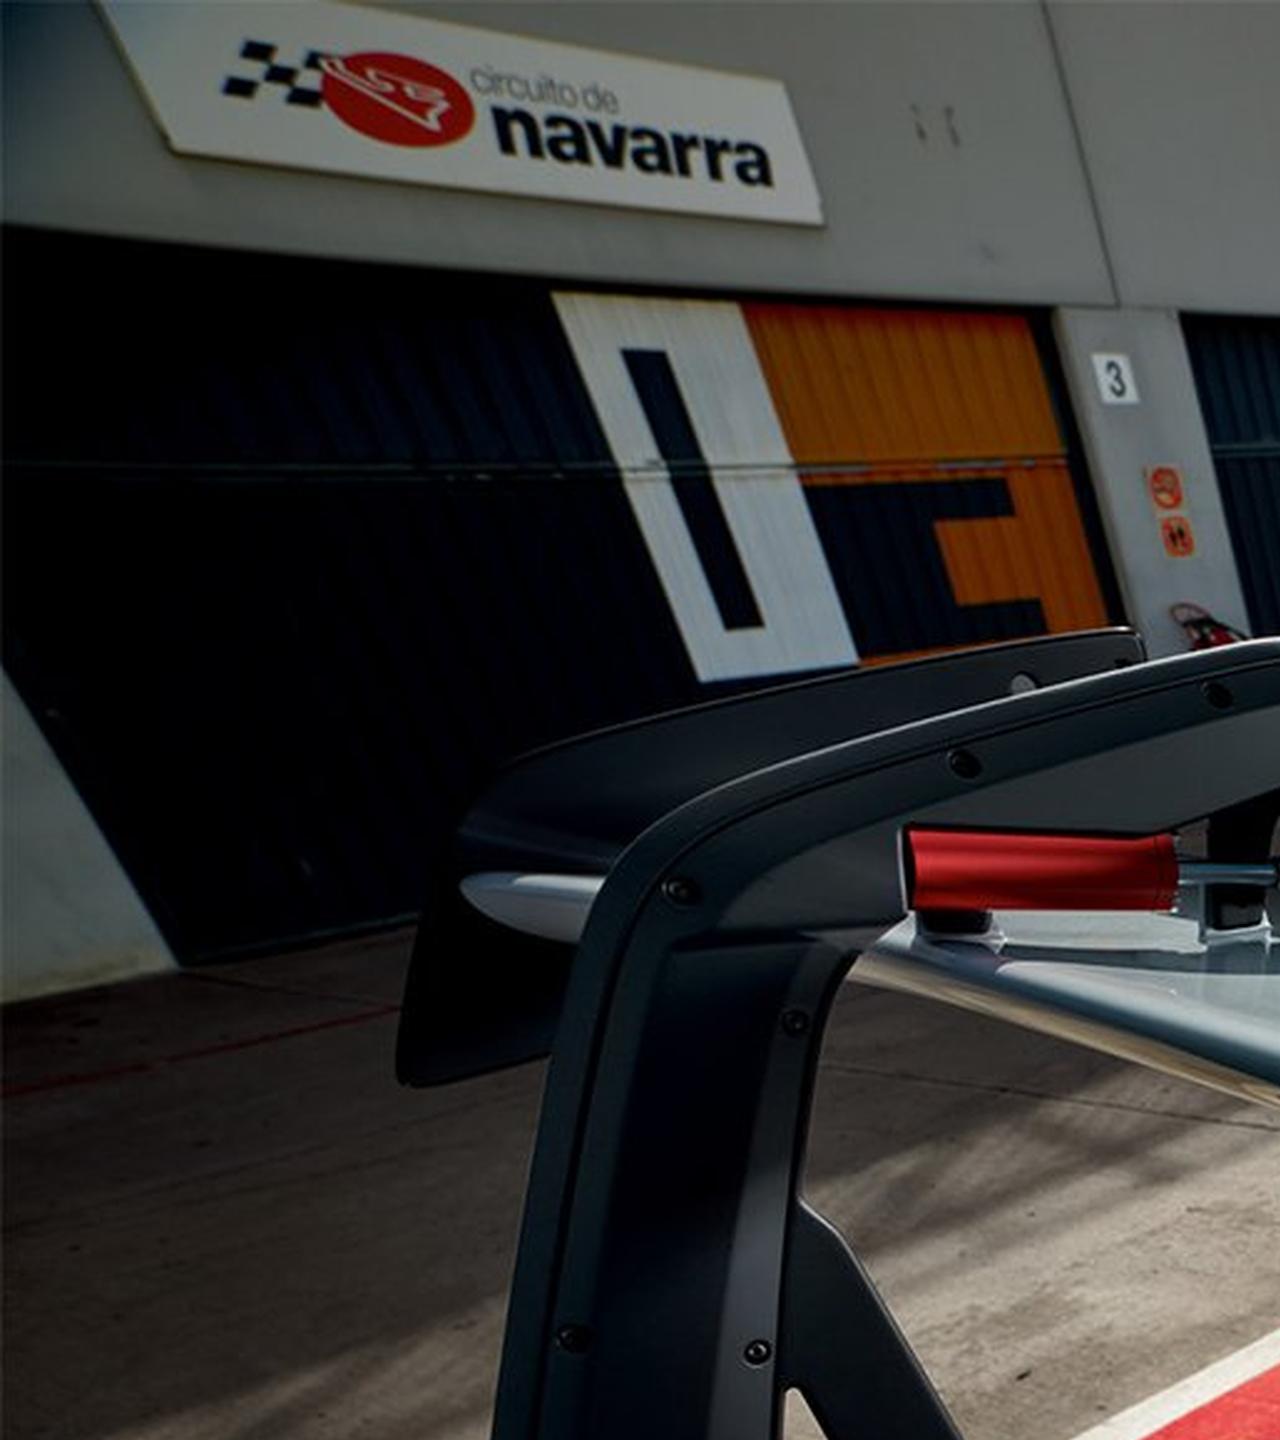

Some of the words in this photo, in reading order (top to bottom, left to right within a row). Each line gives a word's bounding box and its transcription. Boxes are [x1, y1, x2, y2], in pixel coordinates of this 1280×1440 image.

[469, 66, 578, 111] circuito
[581, 86, 620, 114] de
[489, 104, 775, 189] navarra
[1106, 361, 1127, 398] 3
